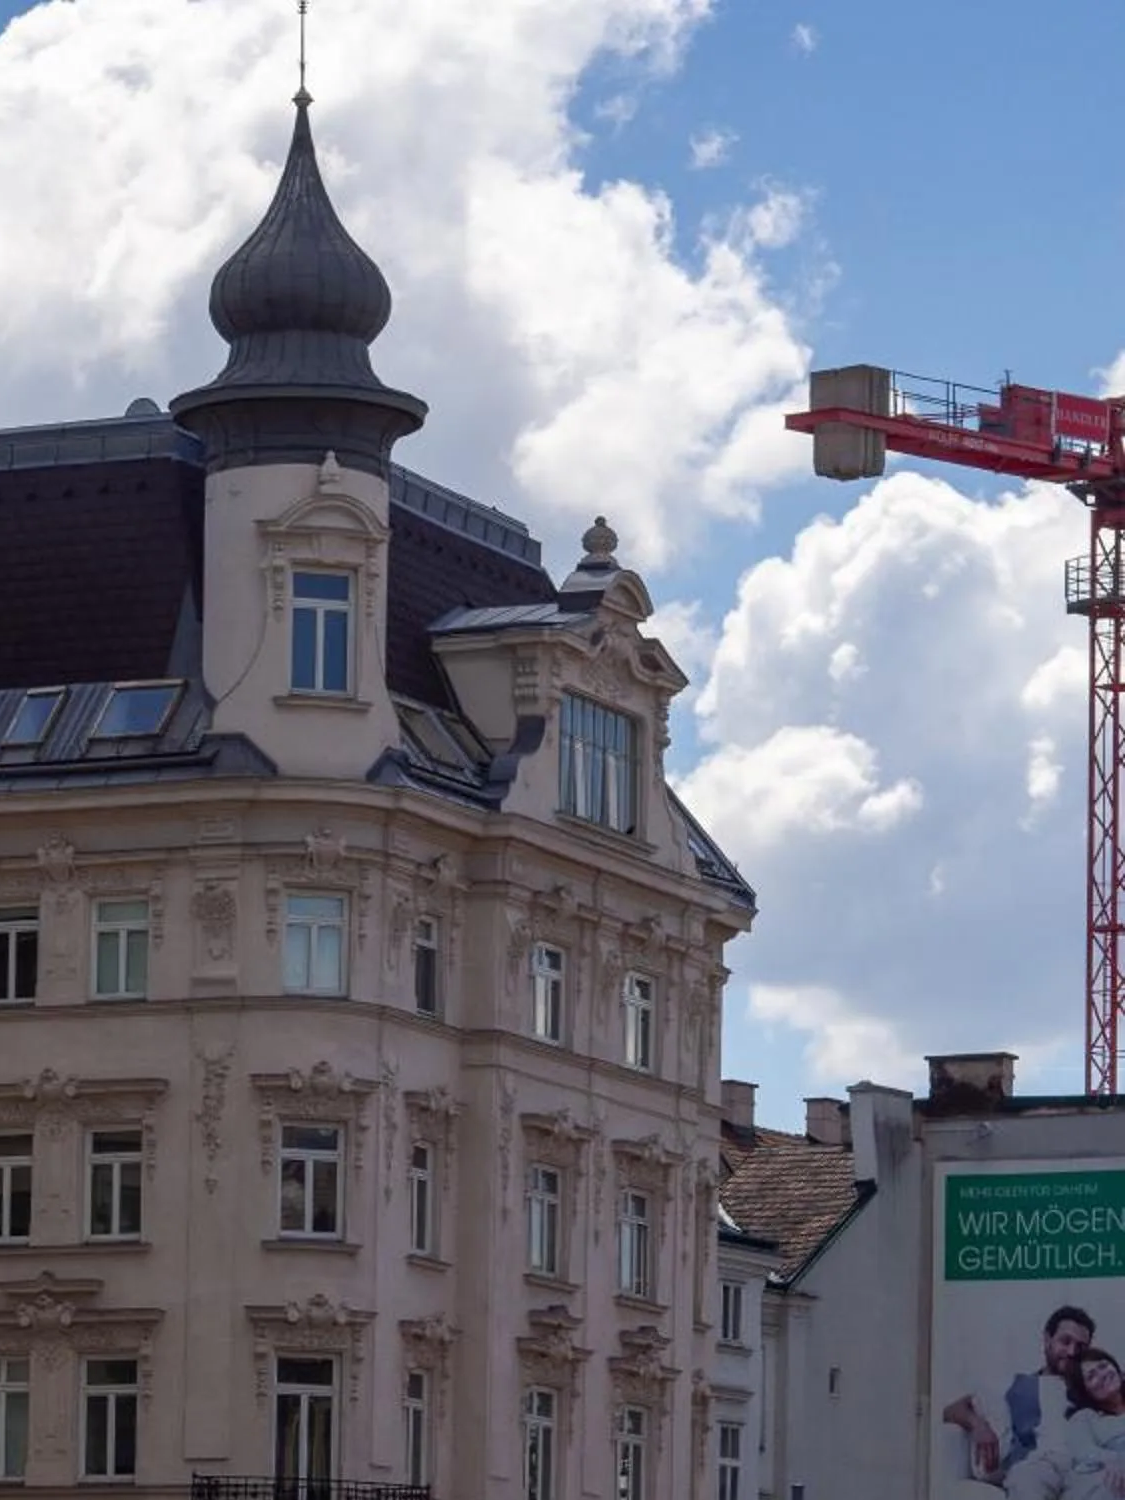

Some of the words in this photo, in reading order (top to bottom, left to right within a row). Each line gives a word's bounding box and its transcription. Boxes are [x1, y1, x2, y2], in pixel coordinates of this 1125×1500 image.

[958, 1210, 1008, 1236] WIR
[1016, 1203, 1125, 1236] MÖGEN
[958, 1239, 1123, 1272] GEMÜTLICH.
